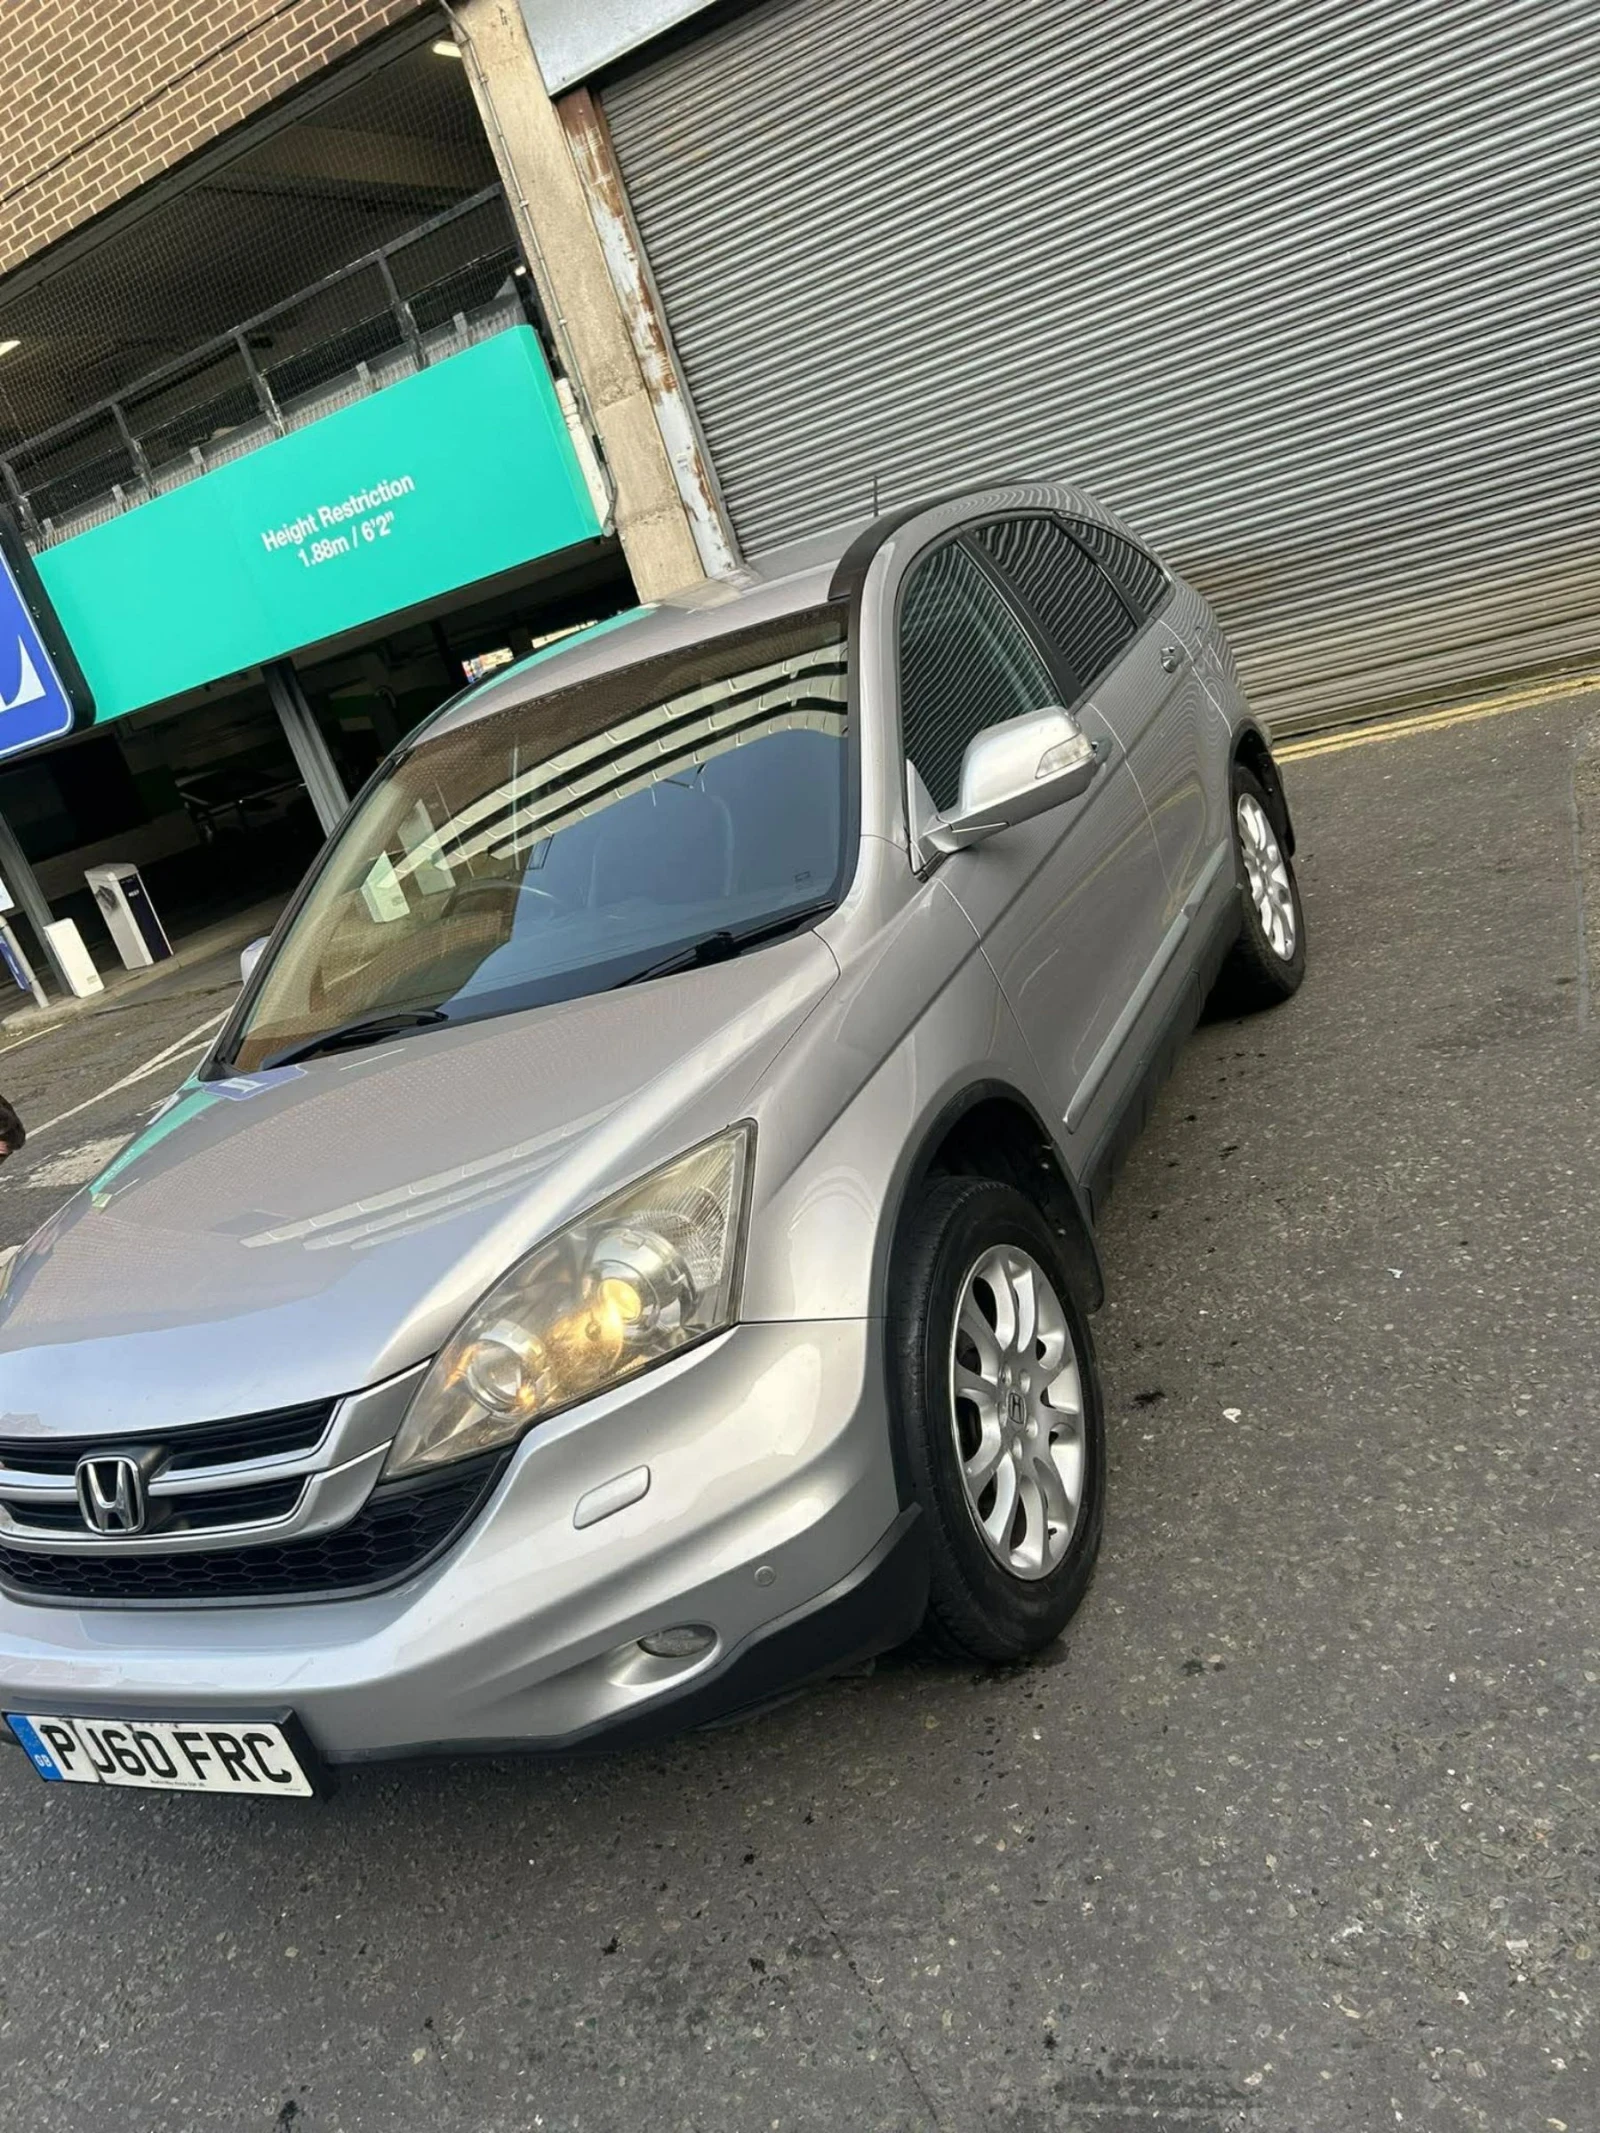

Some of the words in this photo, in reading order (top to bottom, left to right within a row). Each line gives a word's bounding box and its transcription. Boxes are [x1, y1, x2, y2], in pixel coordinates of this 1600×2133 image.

[261, 513, 319, 552] Height
[317, 475, 415, 528] Restriction
[298, 535, 350, 568] 1.88m
[34, 1754, 53, 1768] GB
[40, 1724, 178, 1779] PJ60
[172, 1731, 293, 1784] FRC
